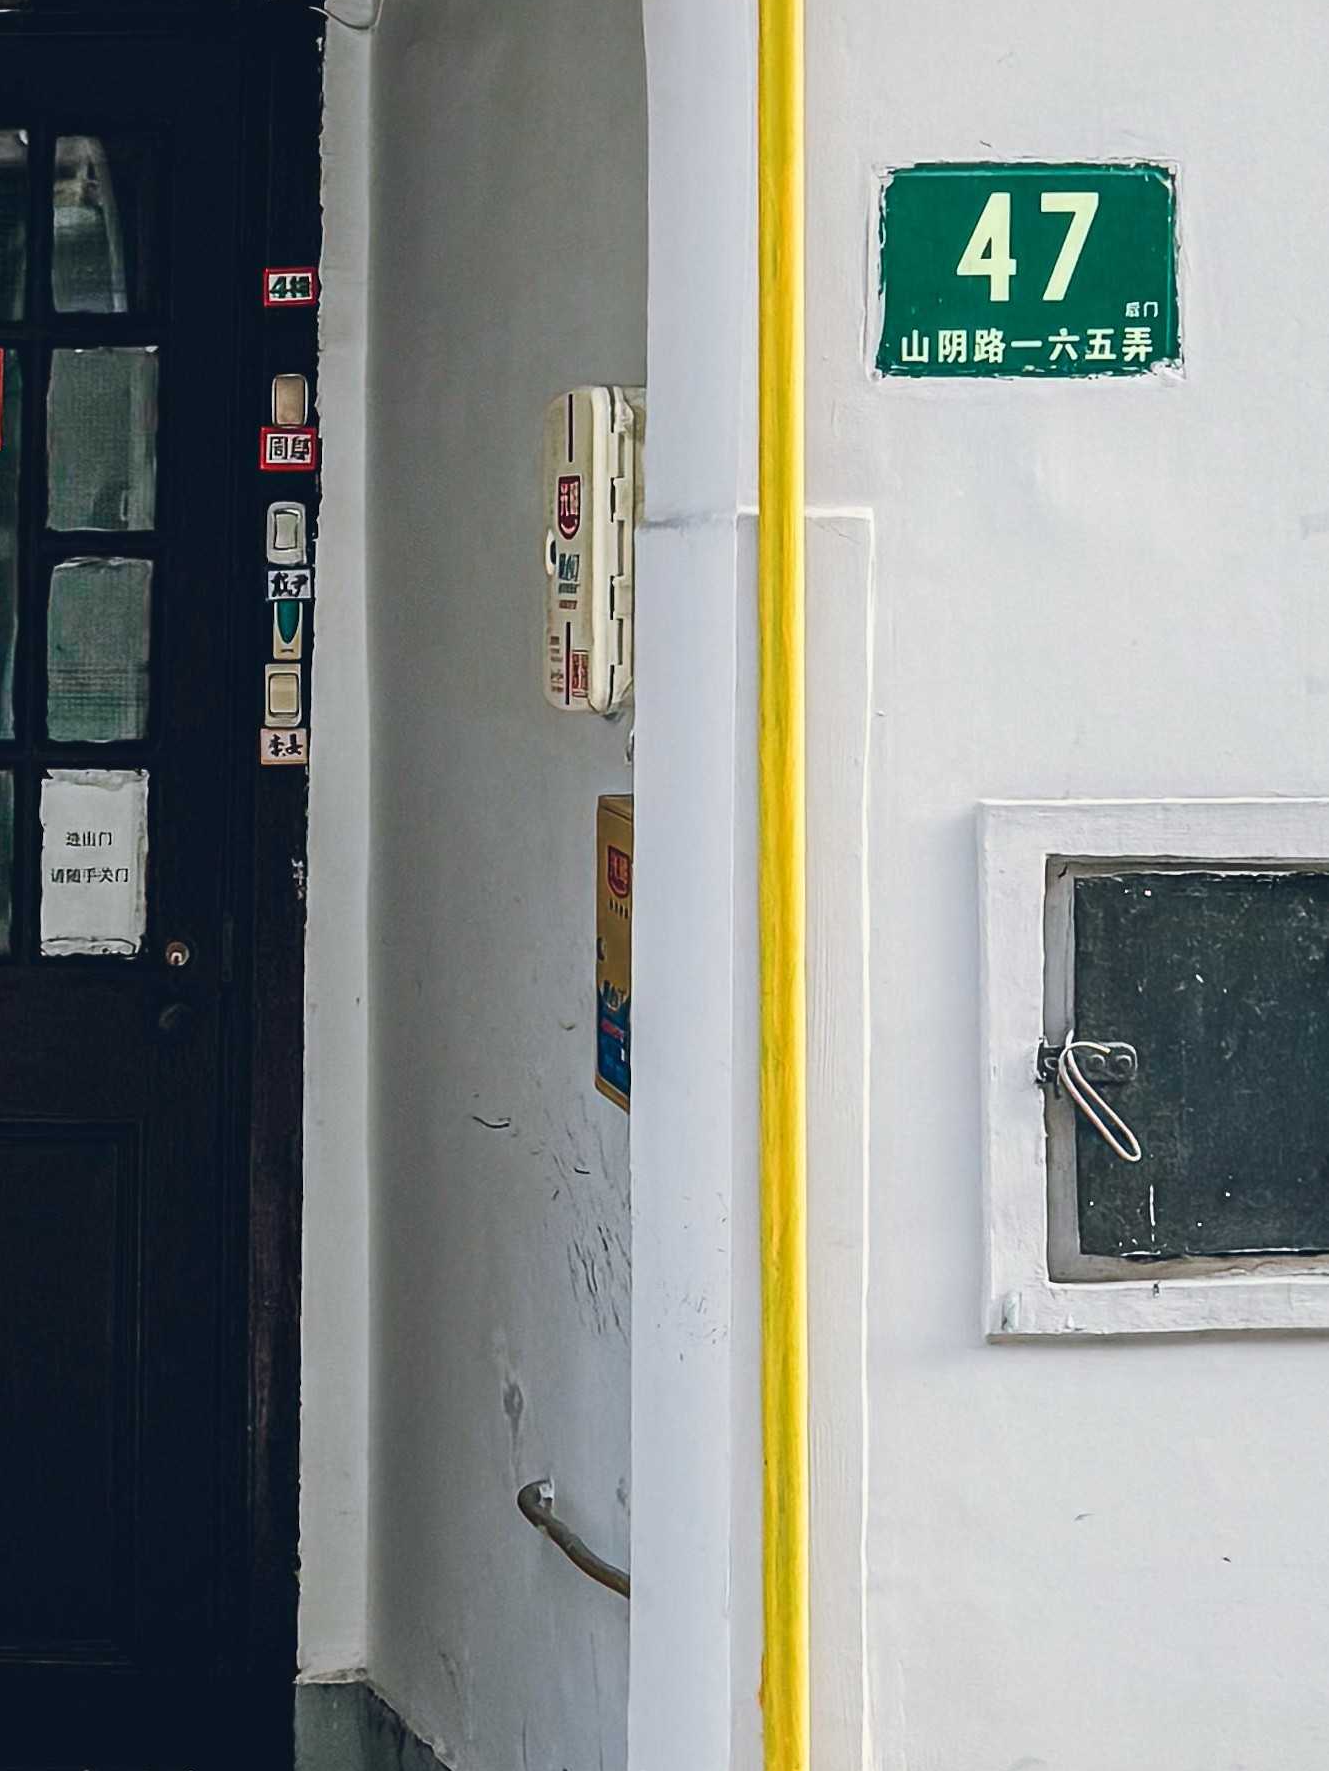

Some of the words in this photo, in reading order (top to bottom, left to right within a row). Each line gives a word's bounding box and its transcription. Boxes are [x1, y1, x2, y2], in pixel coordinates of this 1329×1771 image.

[956, 191, 1099, 302] 47
[901, 326, 1153, 364] 山阴路一六五弄
